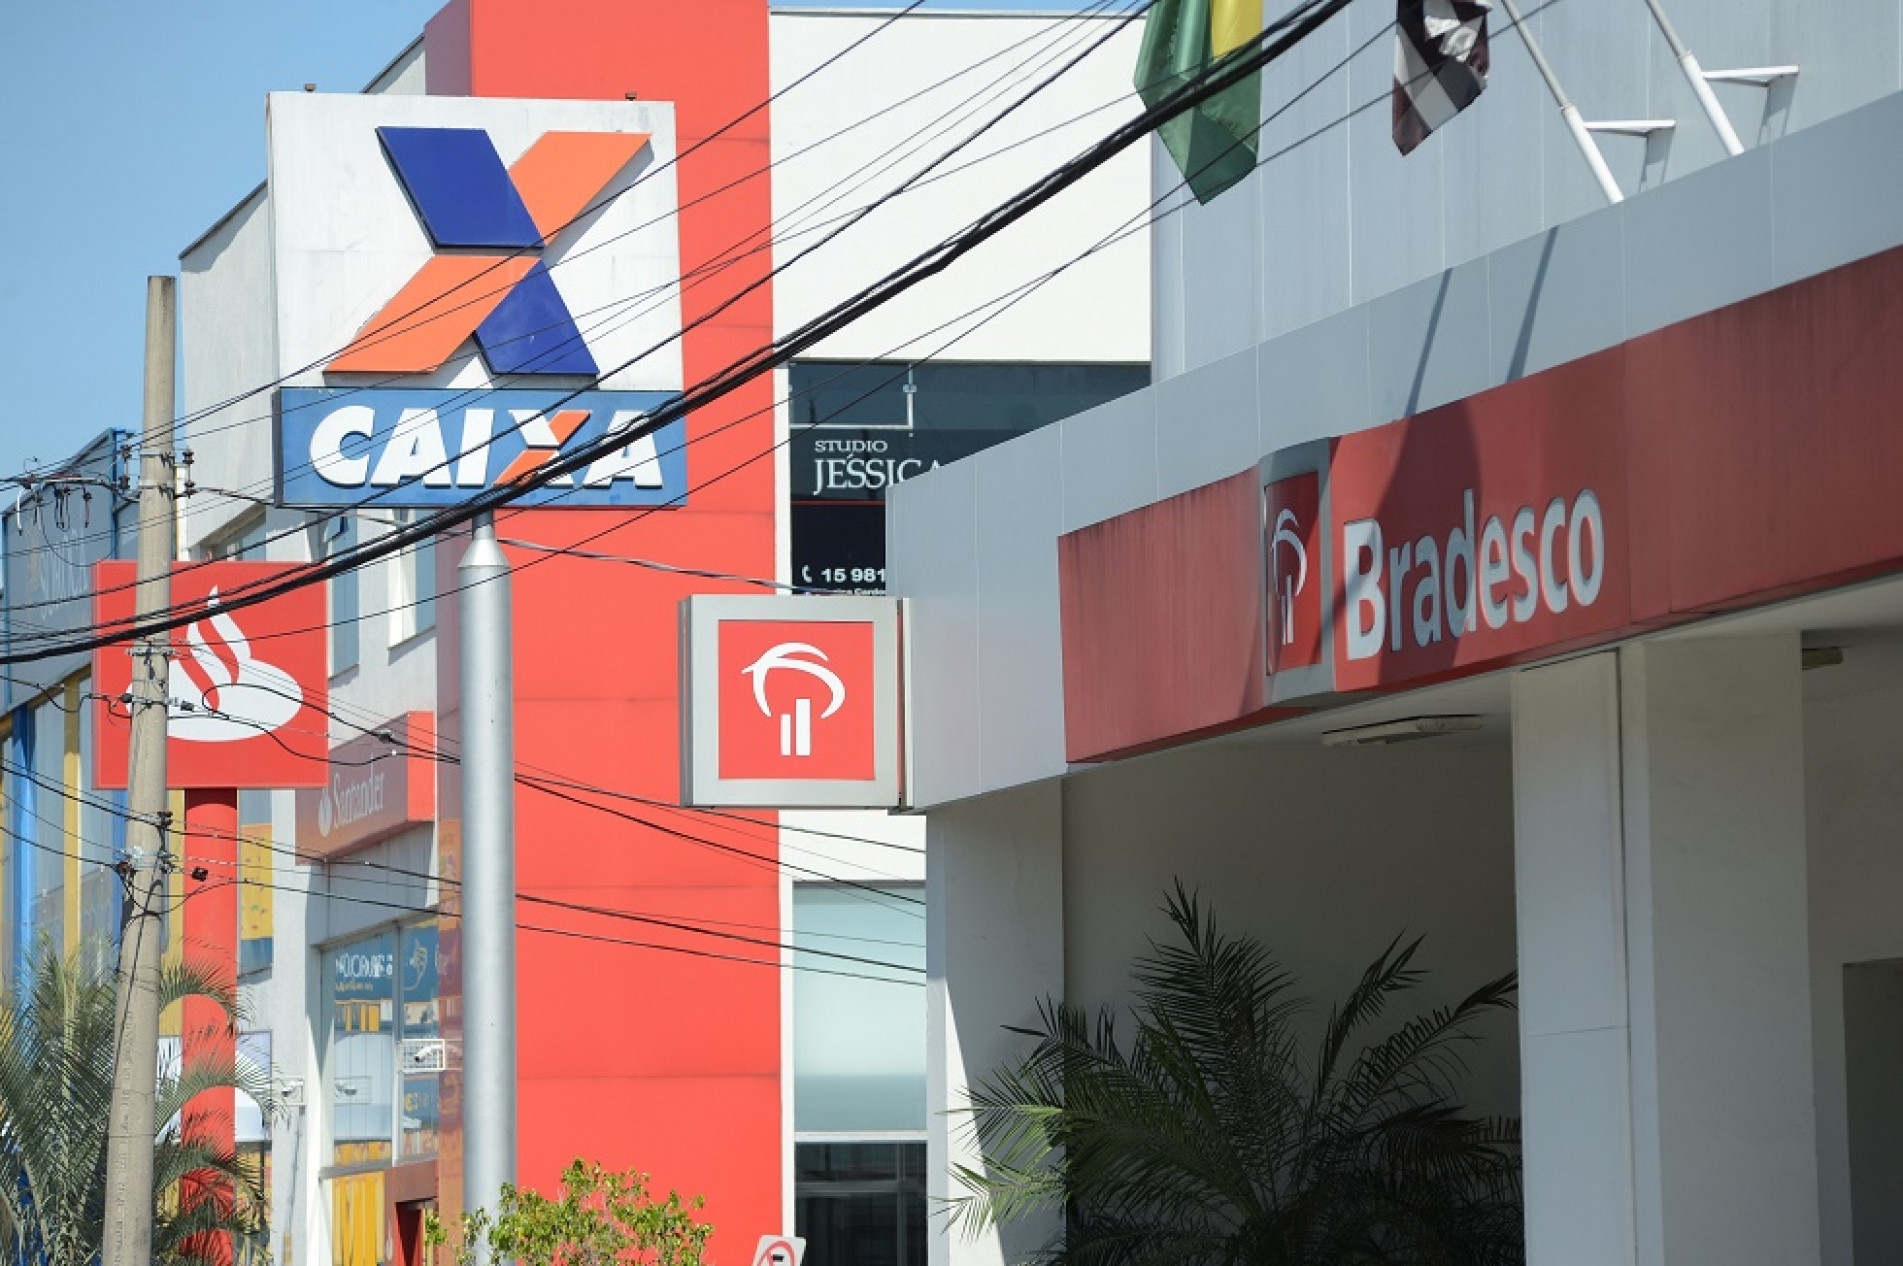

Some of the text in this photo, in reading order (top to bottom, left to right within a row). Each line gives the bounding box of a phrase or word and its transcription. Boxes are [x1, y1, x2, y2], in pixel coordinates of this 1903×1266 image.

[309, 405, 663, 488] CAIXA
[813, 454, 941, 496] JÉSSIC
[814, 440, 888, 453] STUDIO
[821, 567, 886, 583] 15 981
[1343, 487, 1605, 661] Bradesco
[333, 753, 385, 829] Santander
